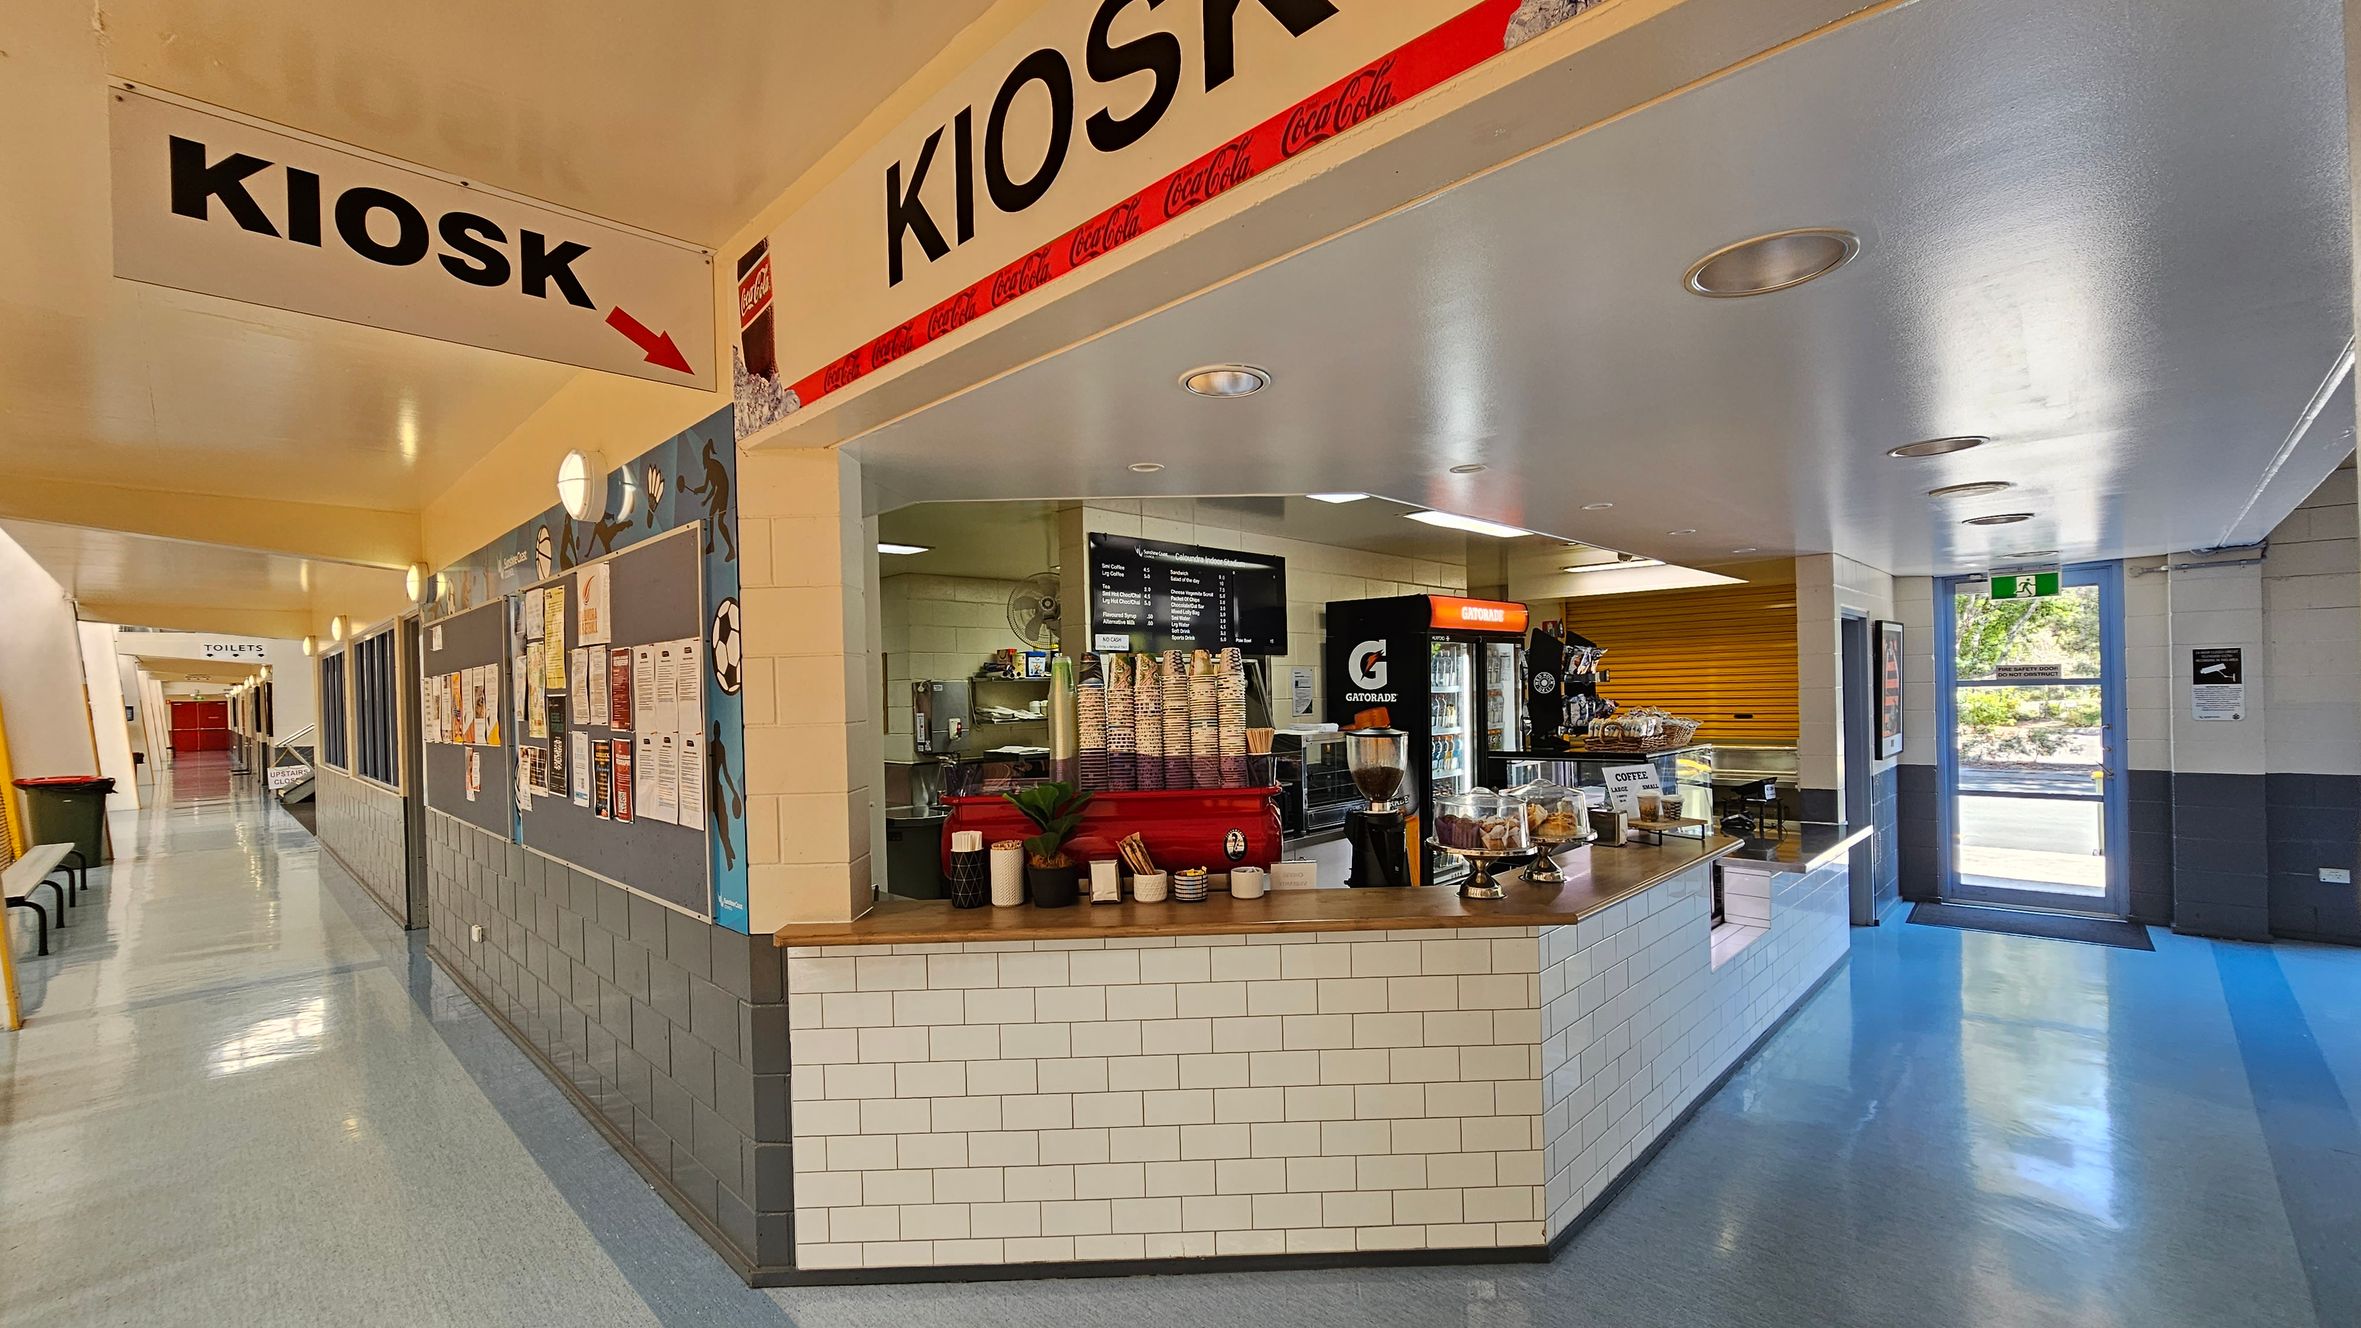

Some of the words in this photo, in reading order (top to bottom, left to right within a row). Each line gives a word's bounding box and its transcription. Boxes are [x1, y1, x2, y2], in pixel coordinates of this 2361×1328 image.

[886, 0, 1340, 288] KIOSK
[168, 134, 598, 312] KIOSK
[1462, 606, 1505, 622] GATORADE
[1345, 692, 1398, 702] GATORADE
[270, 768, 308, 778] UPSTAIRS
[1615, 771, 1648, 782] COFFEE
